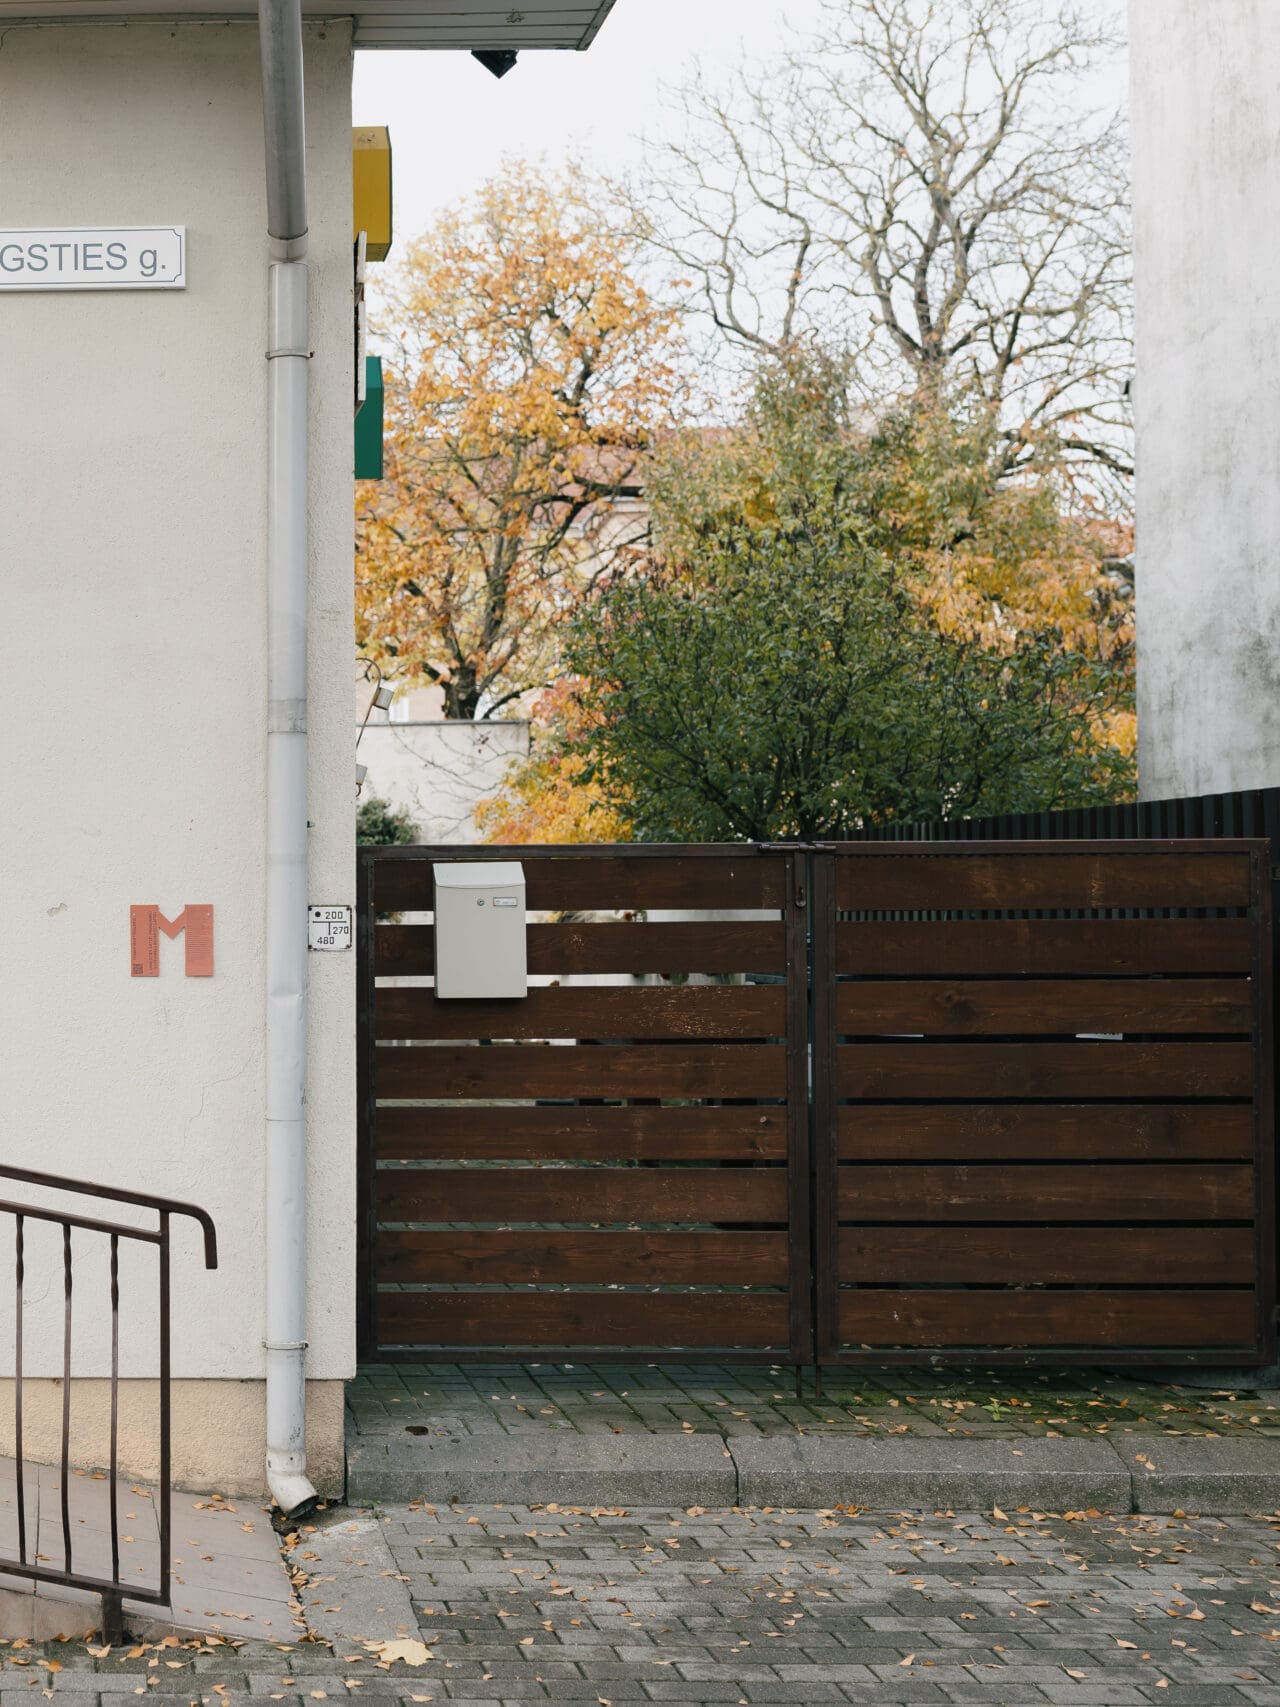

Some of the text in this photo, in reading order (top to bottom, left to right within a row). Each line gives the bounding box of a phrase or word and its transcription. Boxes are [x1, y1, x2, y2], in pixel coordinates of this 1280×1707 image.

[139, 248, 166, 277] g.
[325, 911, 343, 920] 200
[332, 926, 349, 935] 270
[316, 936, 335, 945] 480
